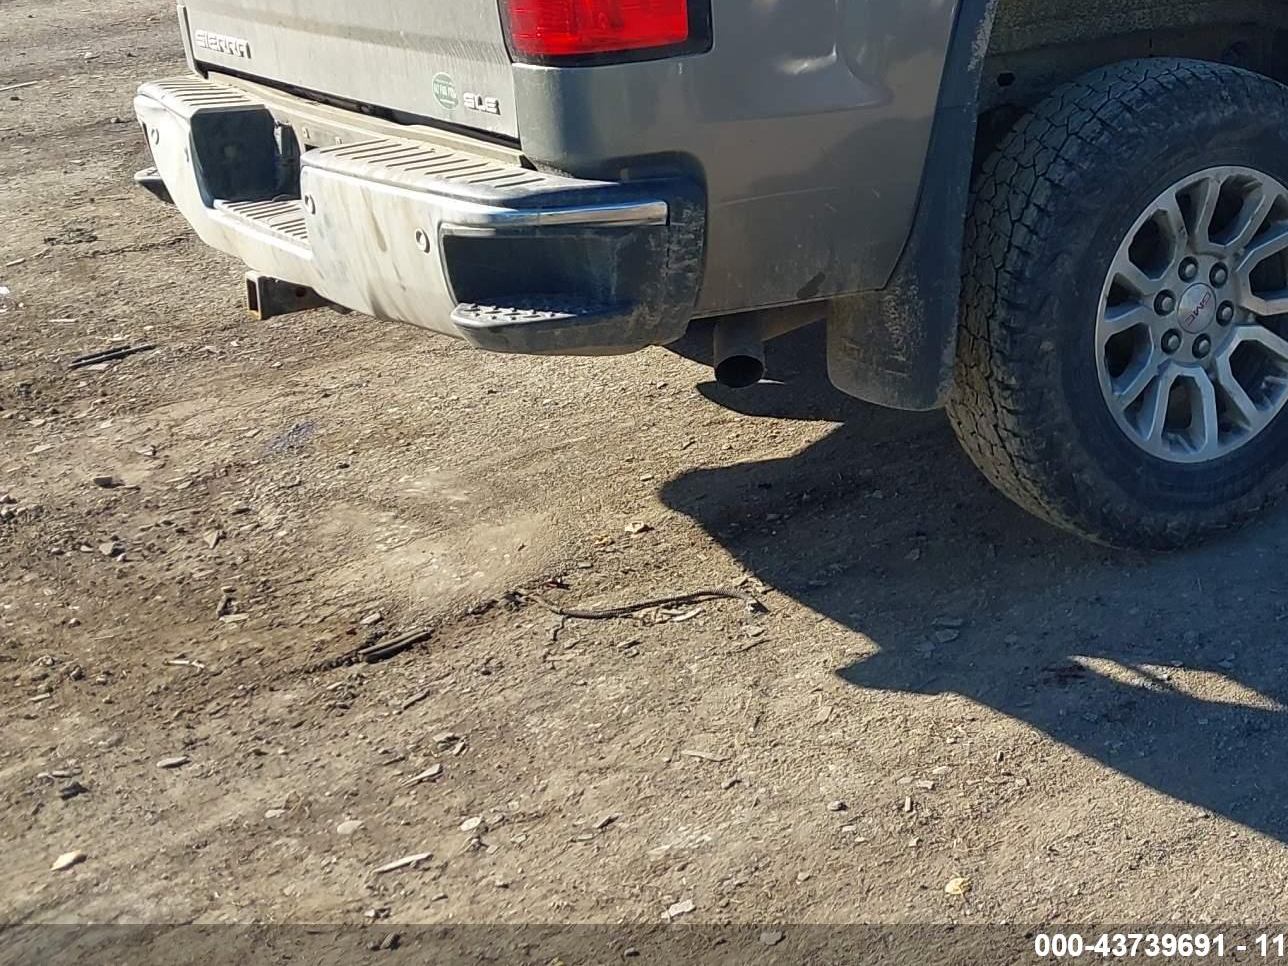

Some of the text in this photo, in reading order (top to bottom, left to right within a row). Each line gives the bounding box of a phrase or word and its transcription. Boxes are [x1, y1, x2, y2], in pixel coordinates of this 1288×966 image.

[195, 30, 252, 59] SIERRA
[463, 92, 502, 115] SLE
[1184, 291, 1212, 326] GMC
